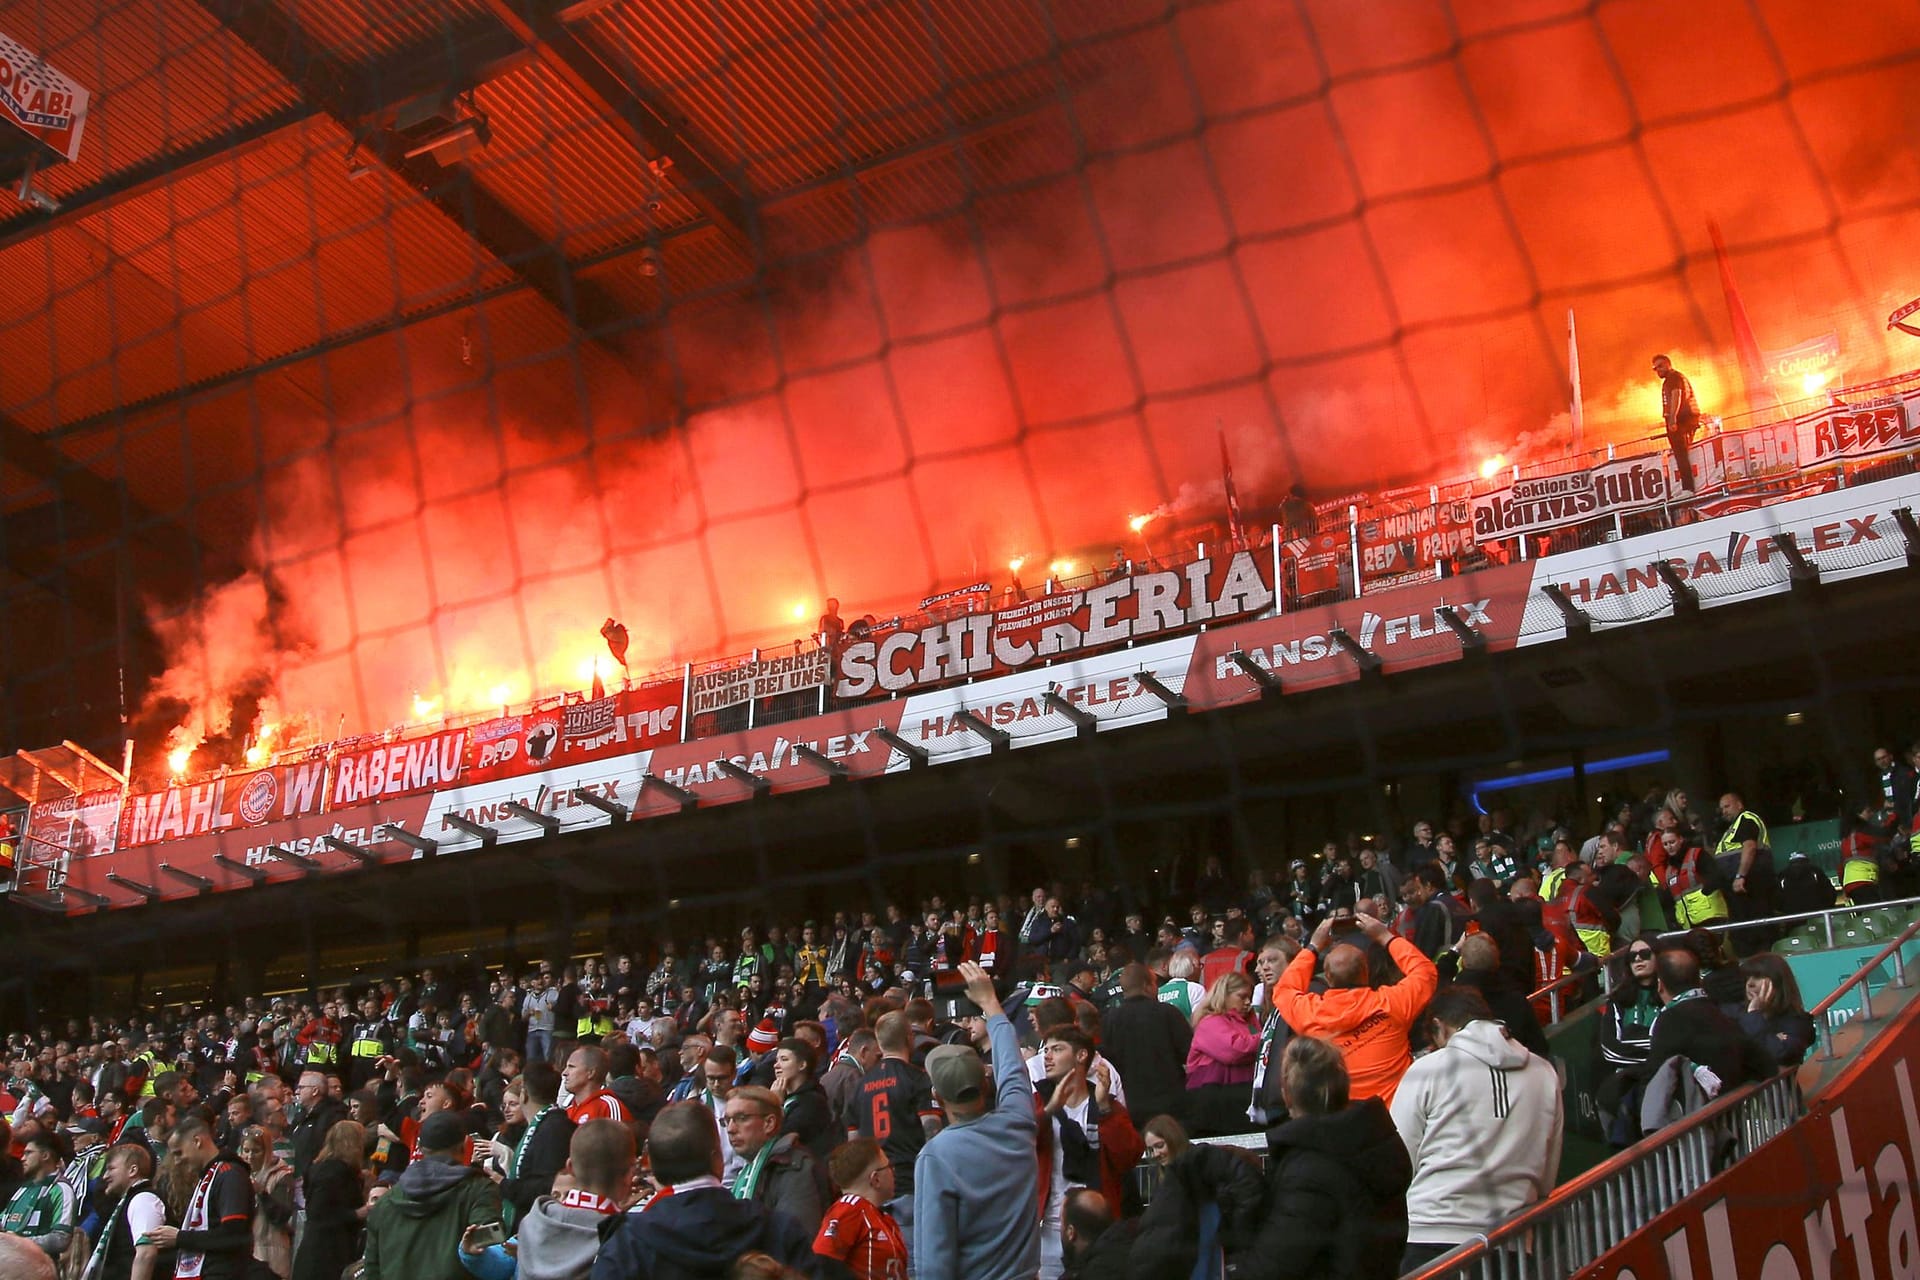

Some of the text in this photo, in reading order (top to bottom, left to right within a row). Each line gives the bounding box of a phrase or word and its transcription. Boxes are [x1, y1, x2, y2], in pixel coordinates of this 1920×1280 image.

[1512, 480, 1567, 499] Sektion
[1364, 543, 1396, 572] RED
[1423, 527, 1475, 562] PRIDE
[1560, 551, 1724, 604] HANSA
[997, 618, 1033, 632] FREUNDE
[1044, 606, 1072, 621] KNAST
[1042, 594, 1073, 609] UNSERE
[836, 551, 1273, 698] SCHICKERIA
[694, 650, 829, 693] AUSGESPERRTE
[694, 683, 750, 713] IMMER
[754, 675, 784, 698] BEI
[790, 665, 826, 688] UNS
[920, 670, 1157, 740] HANSA FLEX
[335, 733, 465, 804] RABENAU
[478, 738, 519, 769] RED
[663, 751, 769, 788] HANSA
[344, 820, 406, 847] FLEX
[872, 1092, 892, 1139] 6
